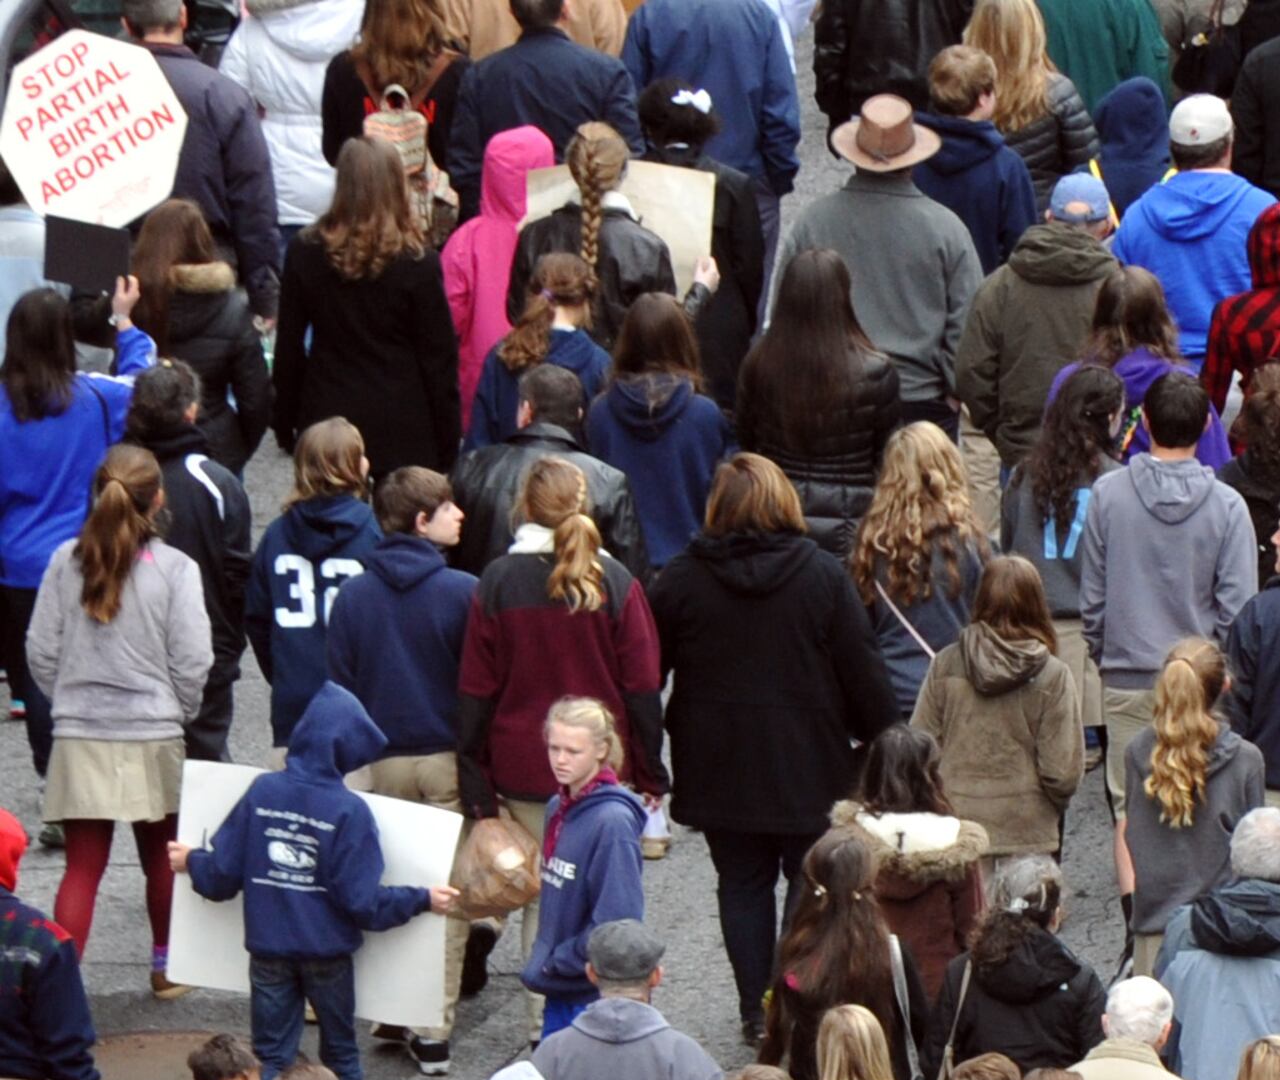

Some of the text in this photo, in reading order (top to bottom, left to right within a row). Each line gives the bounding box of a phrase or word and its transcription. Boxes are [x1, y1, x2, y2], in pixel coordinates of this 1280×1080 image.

[15, 60, 132, 142] PARTIAL
[21, 42, 90, 100] STOP
[40, 102, 176, 205] ABORTION
[48, 93, 130, 158] BIRTH
